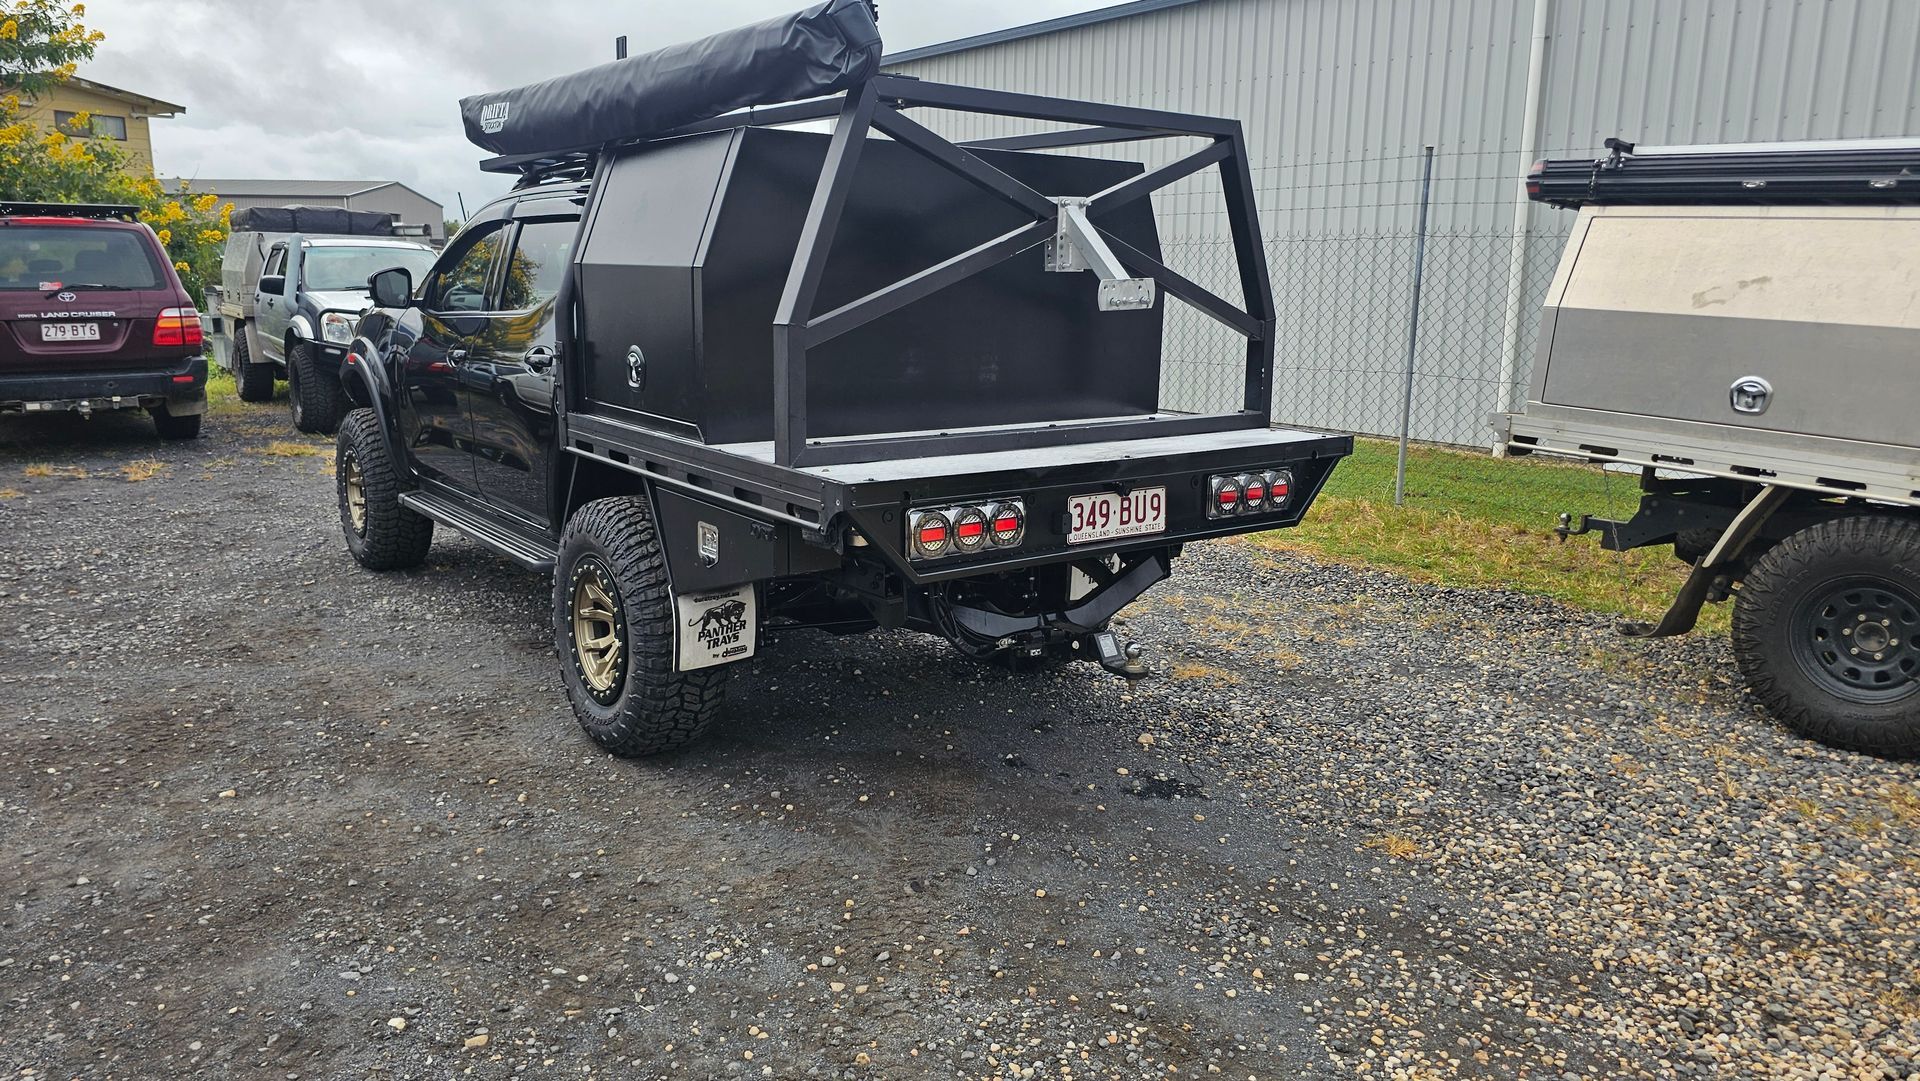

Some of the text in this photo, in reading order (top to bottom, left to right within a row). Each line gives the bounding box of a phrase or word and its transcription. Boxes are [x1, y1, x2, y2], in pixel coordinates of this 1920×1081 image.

[480, 102, 510, 125] DRIFTA
[1073, 522, 1161, 541] QUEENSLAND SUNSHINE STATE
[698, 619, 747, 642] PANTHER
[706, 632, 740, 650] TRAYS
